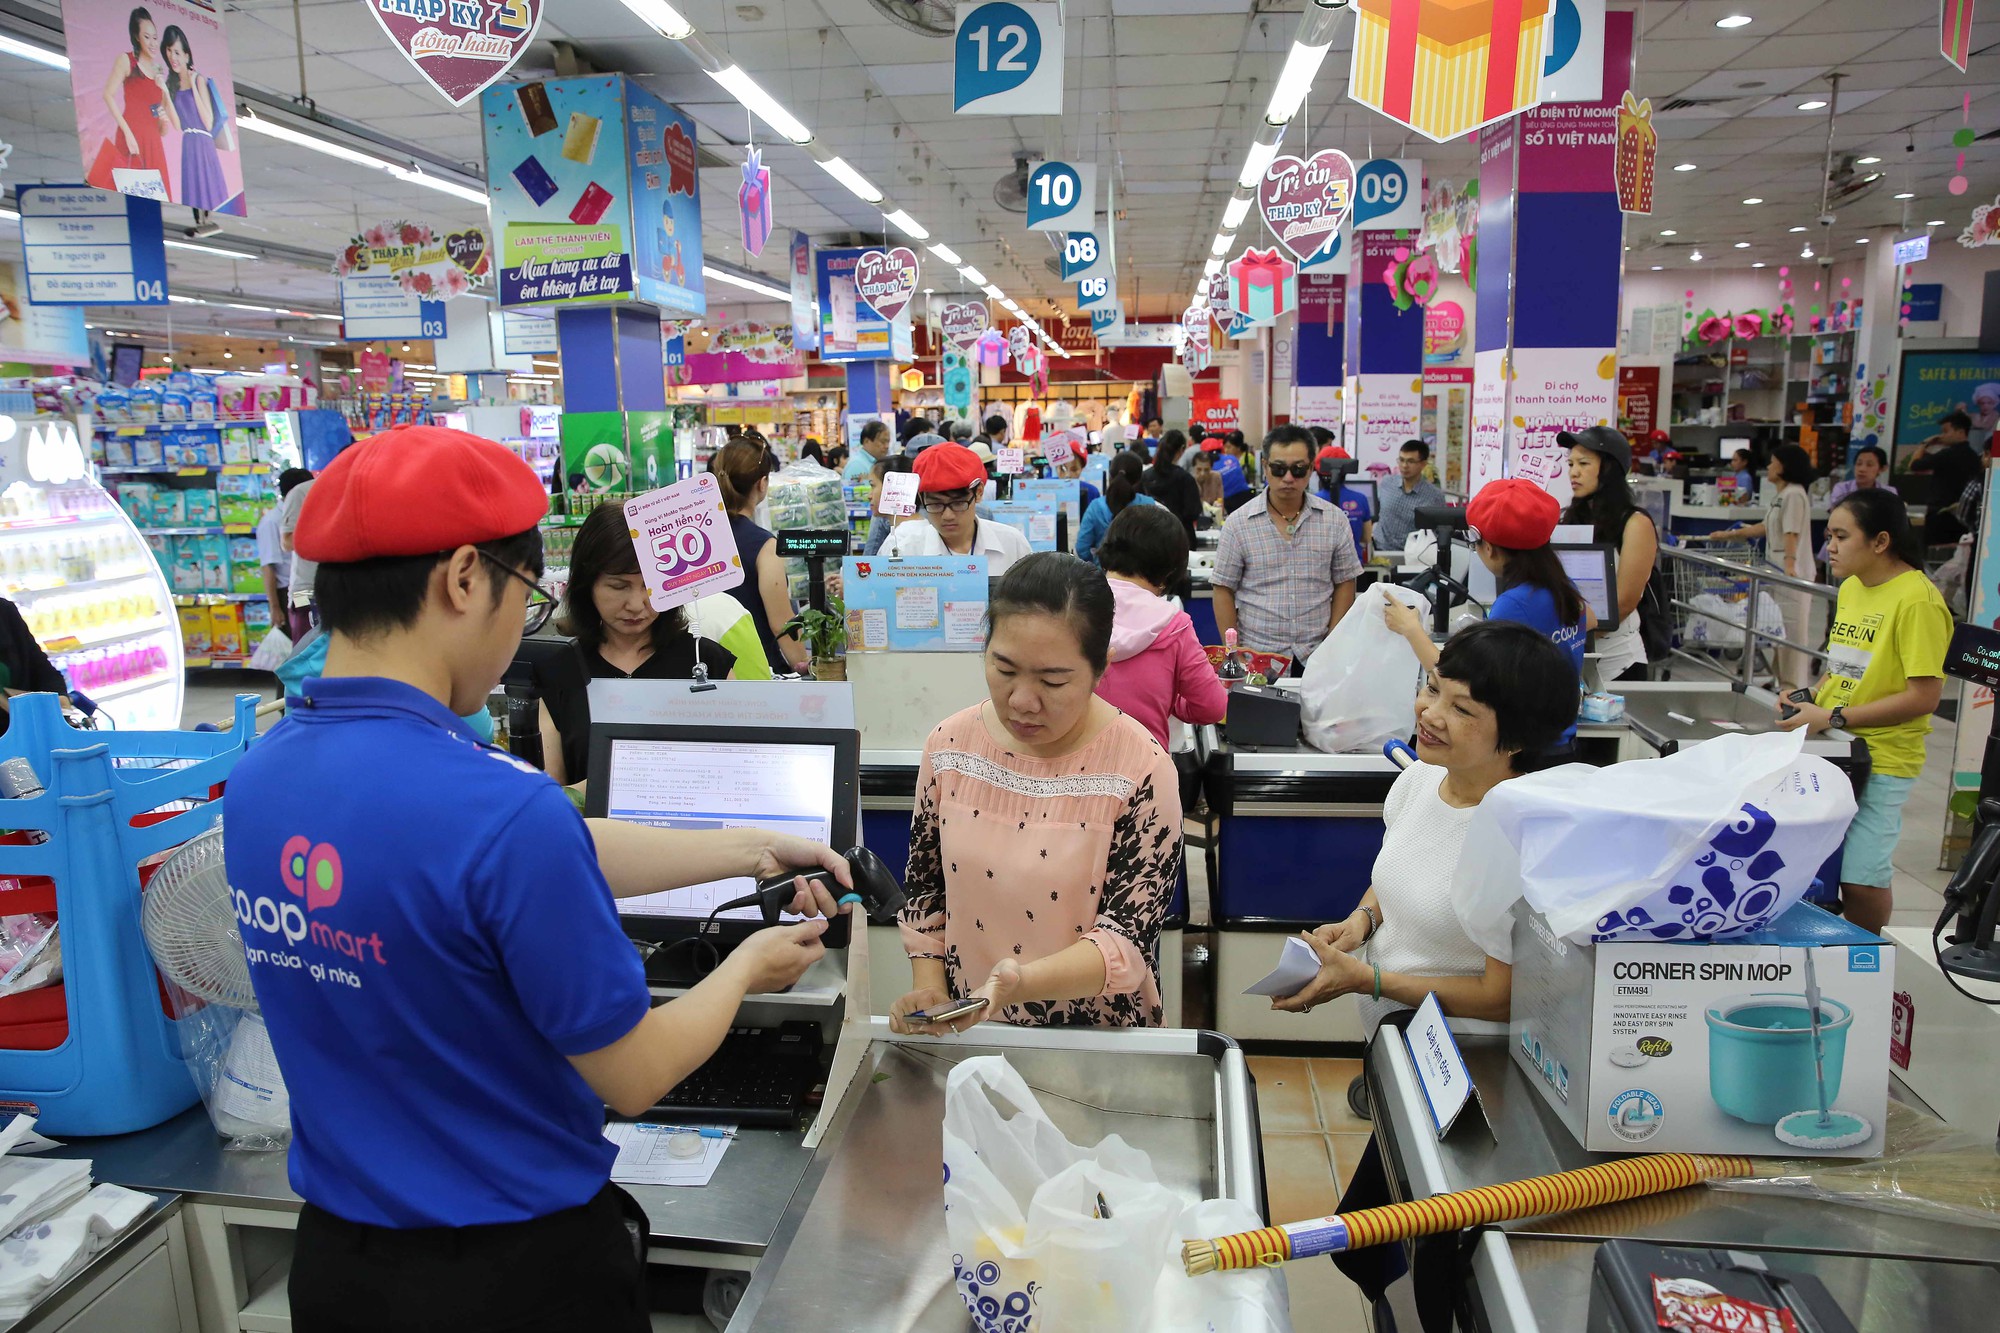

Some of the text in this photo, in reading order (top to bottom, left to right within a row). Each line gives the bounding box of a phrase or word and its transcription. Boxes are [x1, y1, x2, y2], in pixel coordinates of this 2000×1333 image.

[413, 30, 510, 55] đồng hành
[968, 24, 1029, 72] 12
[1540, 105, 1566, 120] ĐIỆN
[1601, 119, 1617, 128] TOÁ
[1525, 128, 1545, 145] SỐ
[1547, 133, 1553, 145] 1
[1556, 130, 1584, 148] VIỆT
[1587, 133, 1617, 145] NAM
[1035, 174, 1074, 207] 10
[1267, 162, 1331, 204] Tri ân
[1361, 173, 1402, 204] 09
[1268, 181, 1349, 221] THẬP KỶ 3
[1065, 237, 1097, 264] 08
[510, 256, 548, 280] Mua
[550, 258, 580, 278] hàng
[860, 257, 883, 283] Tri
[136, 280, 164, 302] 04
[520, 283, 539, 299] ôm
[541, 279, 577, 299] không
[600, 275, 621, 295] tay
[1080, 277, 1107, 297] 06
[1095, 309, 1117, 322] 04
[423, 321, 443, 336] 03
[669, 353, 682, 364] 01
[1919, 367, 1946, 381] SAFE
[1949, 368, 1957, 380] &
[1545, 381, 1579, 393] Đi chợ
[1515, 394, 1607, 403] thanh toán MoMo
[1525, 412, 1564, 431] HOÀN
[663, 509, 678, 518] MoMo
[679, 503, 694, 513] Thanh
[648, 514, 694, 537] Hoàn tiền
[707, 563, 722, 575] 1.11
[1832, 621, 1876, 643] BERLIN
[1962, 653, 1999, 670] Chao Mung
[653, 820, 671, 828] MoMo
[270, 950, 302, 969] của
[328, 966, 362, 989] nhà
[1613, 961, 1792, 982] CORNER SPIN MOP
[1617, 986, 1649, 995] ETM494
[1639, 1039, 1673, 1056] Refill
[1612, 1091, 1660, 1110] FOLDABLE HEAD
[1612, 1122, 1658, 1140] DURABLE EASIER
